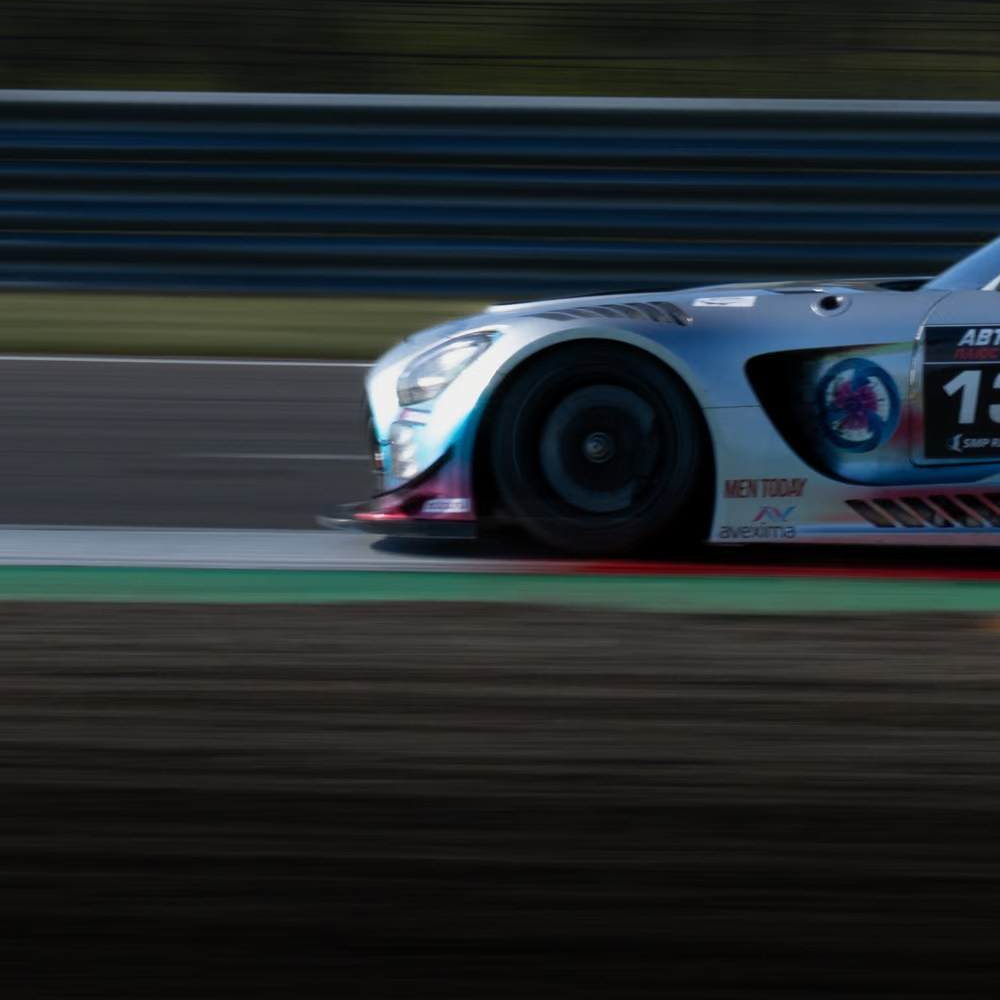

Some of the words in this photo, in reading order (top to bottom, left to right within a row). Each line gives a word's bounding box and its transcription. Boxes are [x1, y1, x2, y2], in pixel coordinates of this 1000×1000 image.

[962, 437, 990, 448] SMP
[724, 478, 757, 499] MEN
[760, 477, 808, 498] TODAY
[719, 521, 797, 539] avexima
